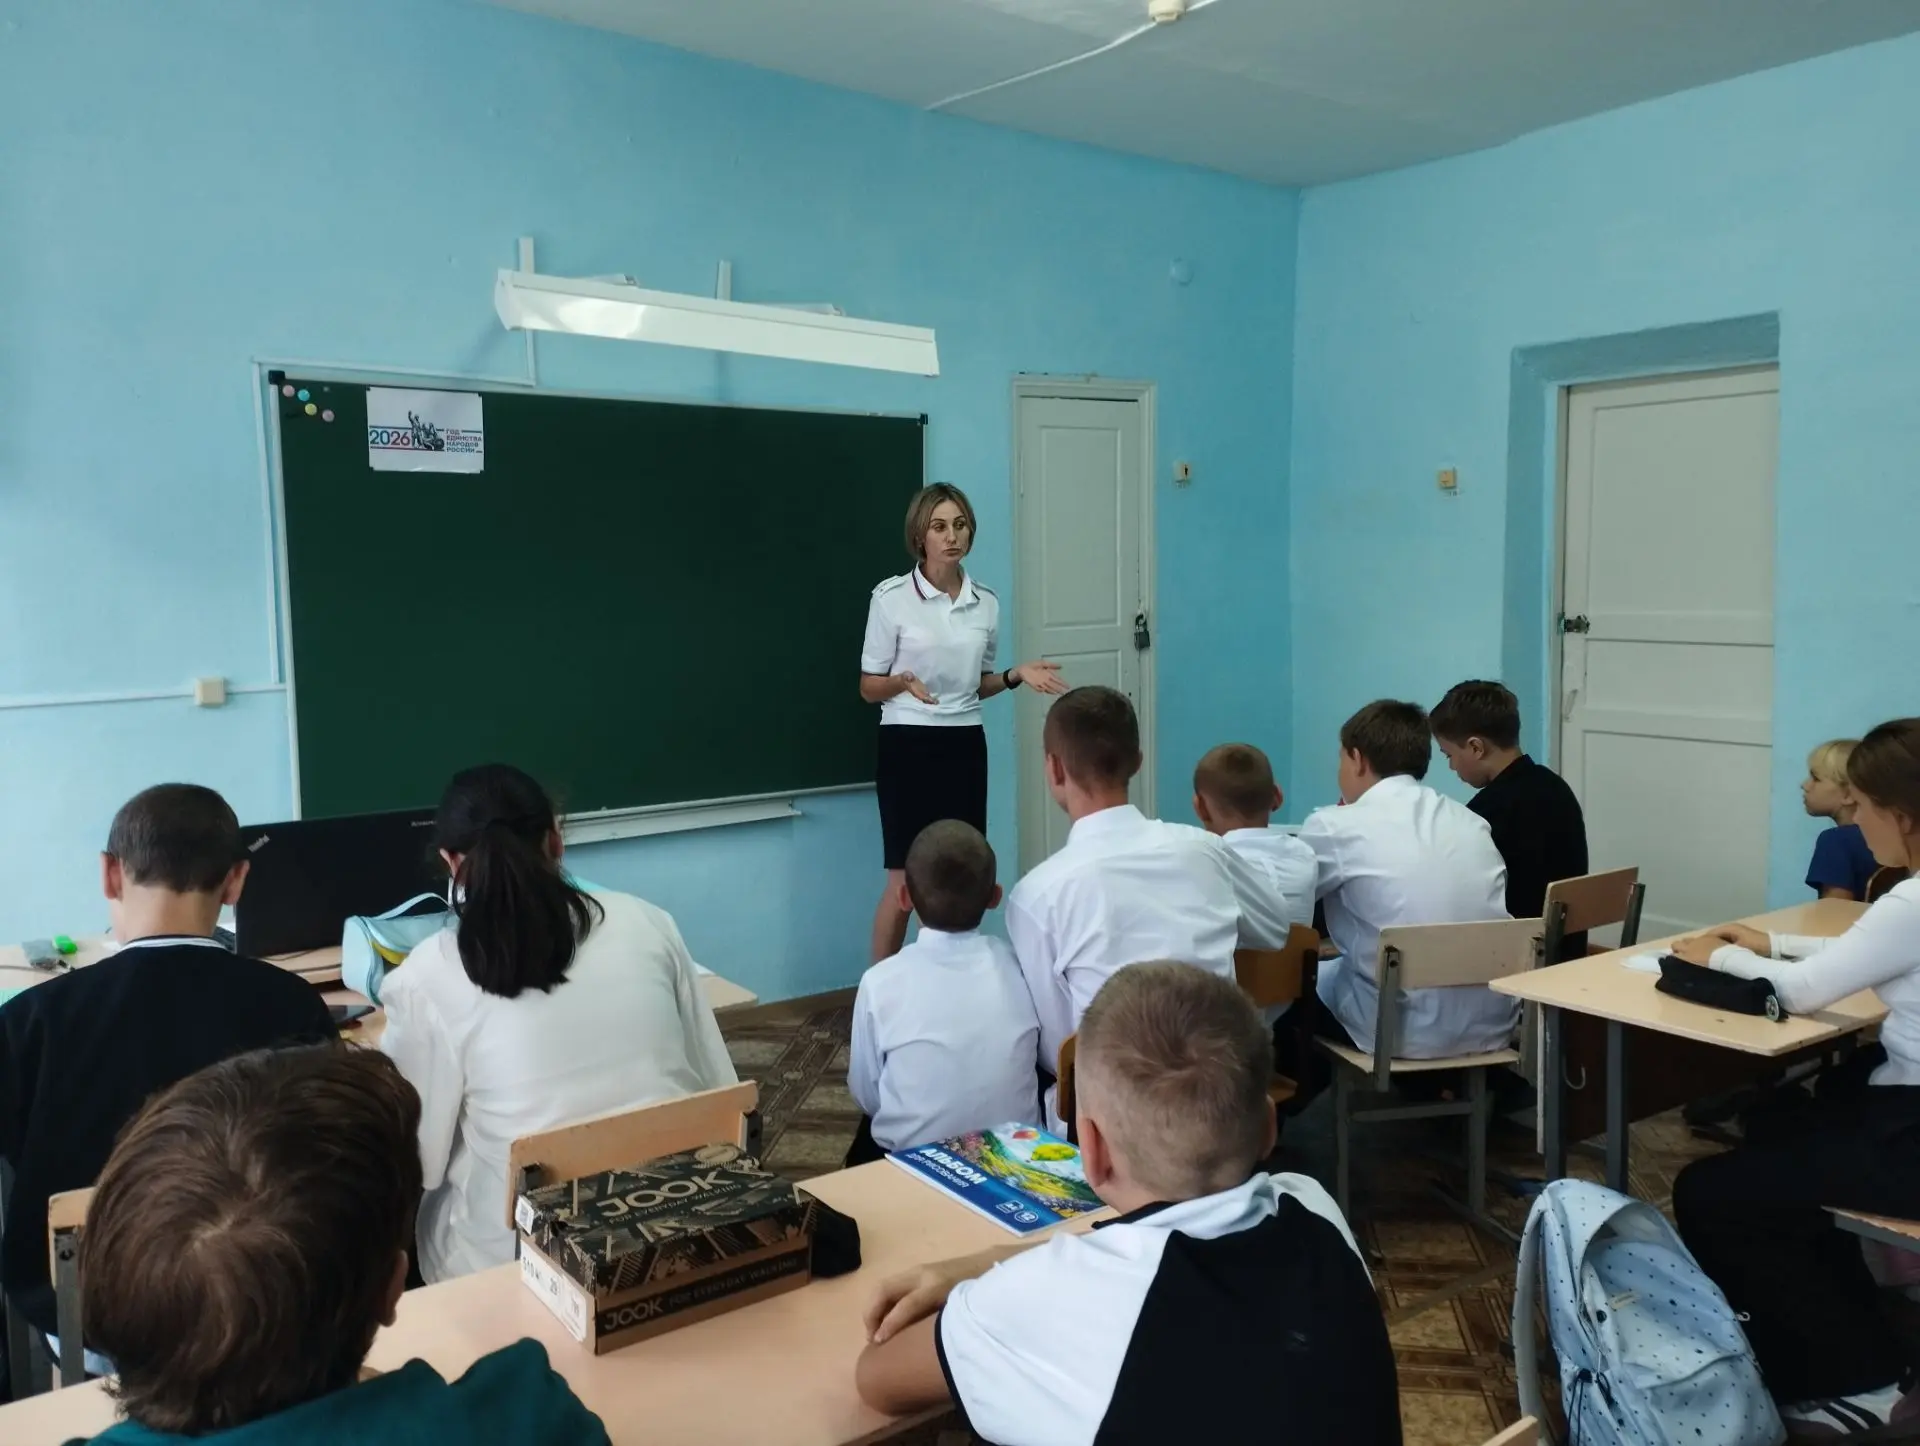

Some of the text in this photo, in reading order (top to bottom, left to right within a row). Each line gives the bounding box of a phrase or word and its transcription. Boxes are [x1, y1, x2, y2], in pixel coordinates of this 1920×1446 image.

[369, 430, 411, 446] 2026
[919, 1148, 988, 1185] АЛЬБОМ
[597, 1171, 734, 1217] JOOK
[604, 1298, 664, 1331] JOOK
